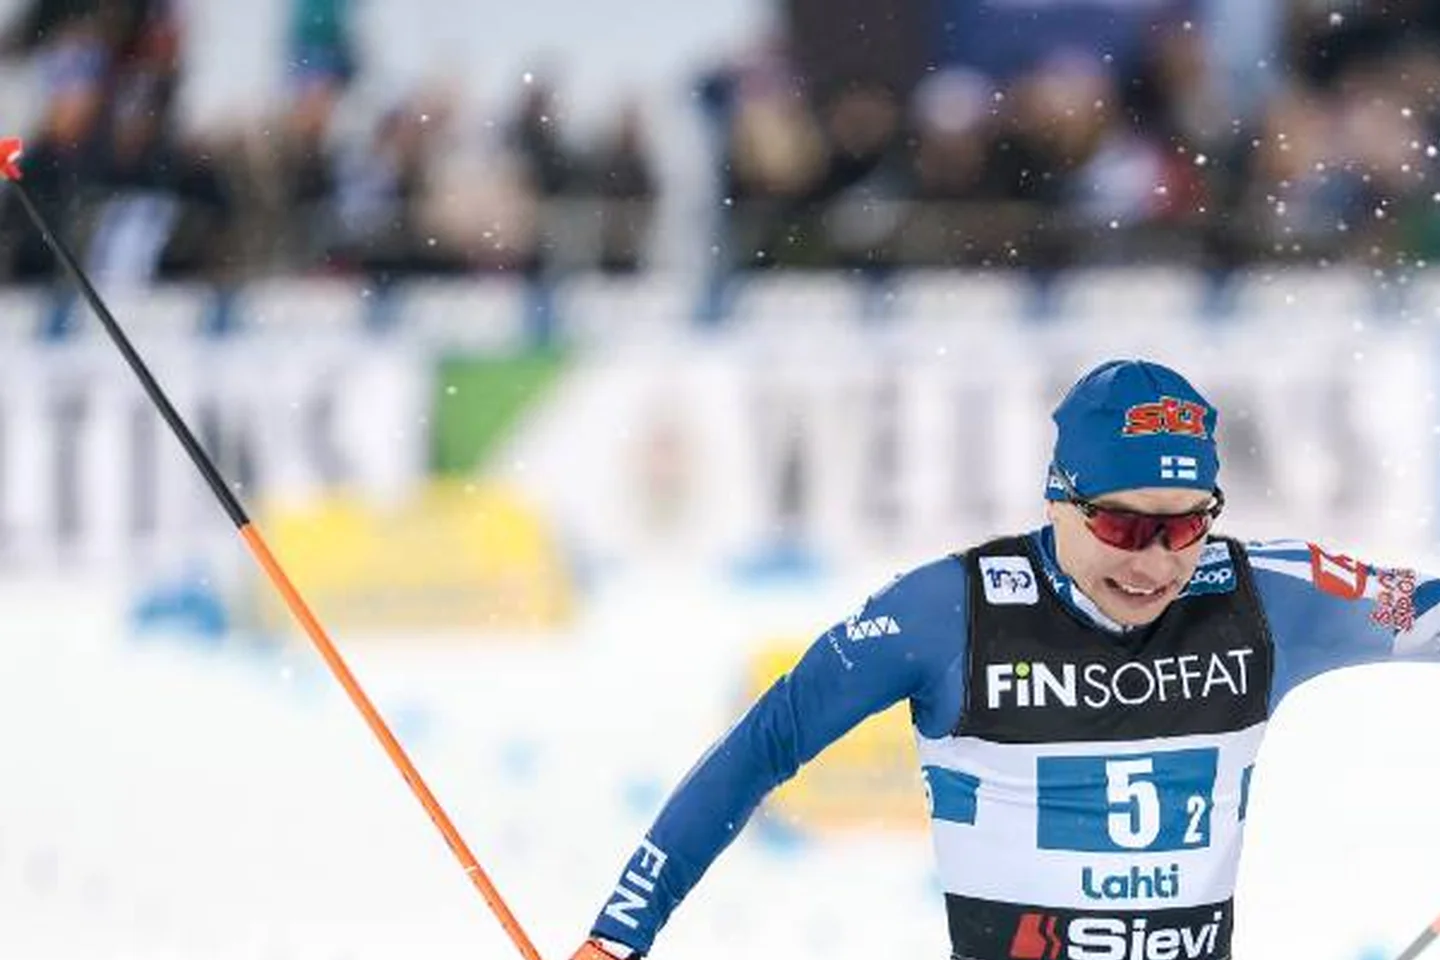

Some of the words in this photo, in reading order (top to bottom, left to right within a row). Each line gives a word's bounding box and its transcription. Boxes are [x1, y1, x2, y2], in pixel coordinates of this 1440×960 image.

[1104, 758, 1161, 849] 5
[1183, 795, 1208, 843] 2
[604, 839, 669, 929] FIN
[1081, 863, 1180, 900] Lahti
